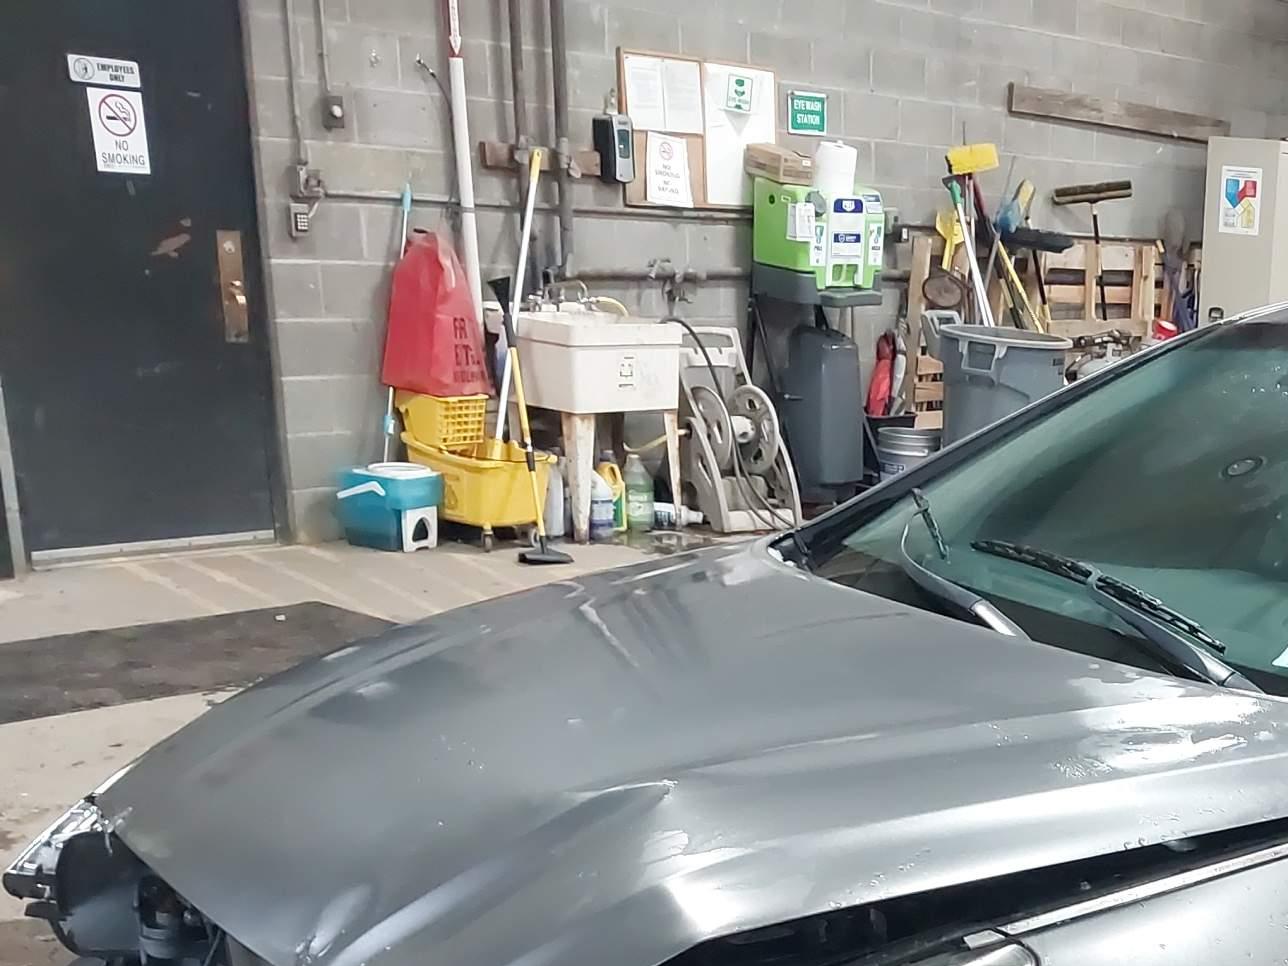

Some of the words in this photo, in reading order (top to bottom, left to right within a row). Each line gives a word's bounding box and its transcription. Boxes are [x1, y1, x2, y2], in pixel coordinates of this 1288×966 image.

[97, 63, 135, 75] EMPLOYEES
[109, 73, 125, 83] ONLY
[796, 113, 821, 125] STATION
[114, 140, 129, 151] NO
[101, 152, 145, 166] SMOKING
